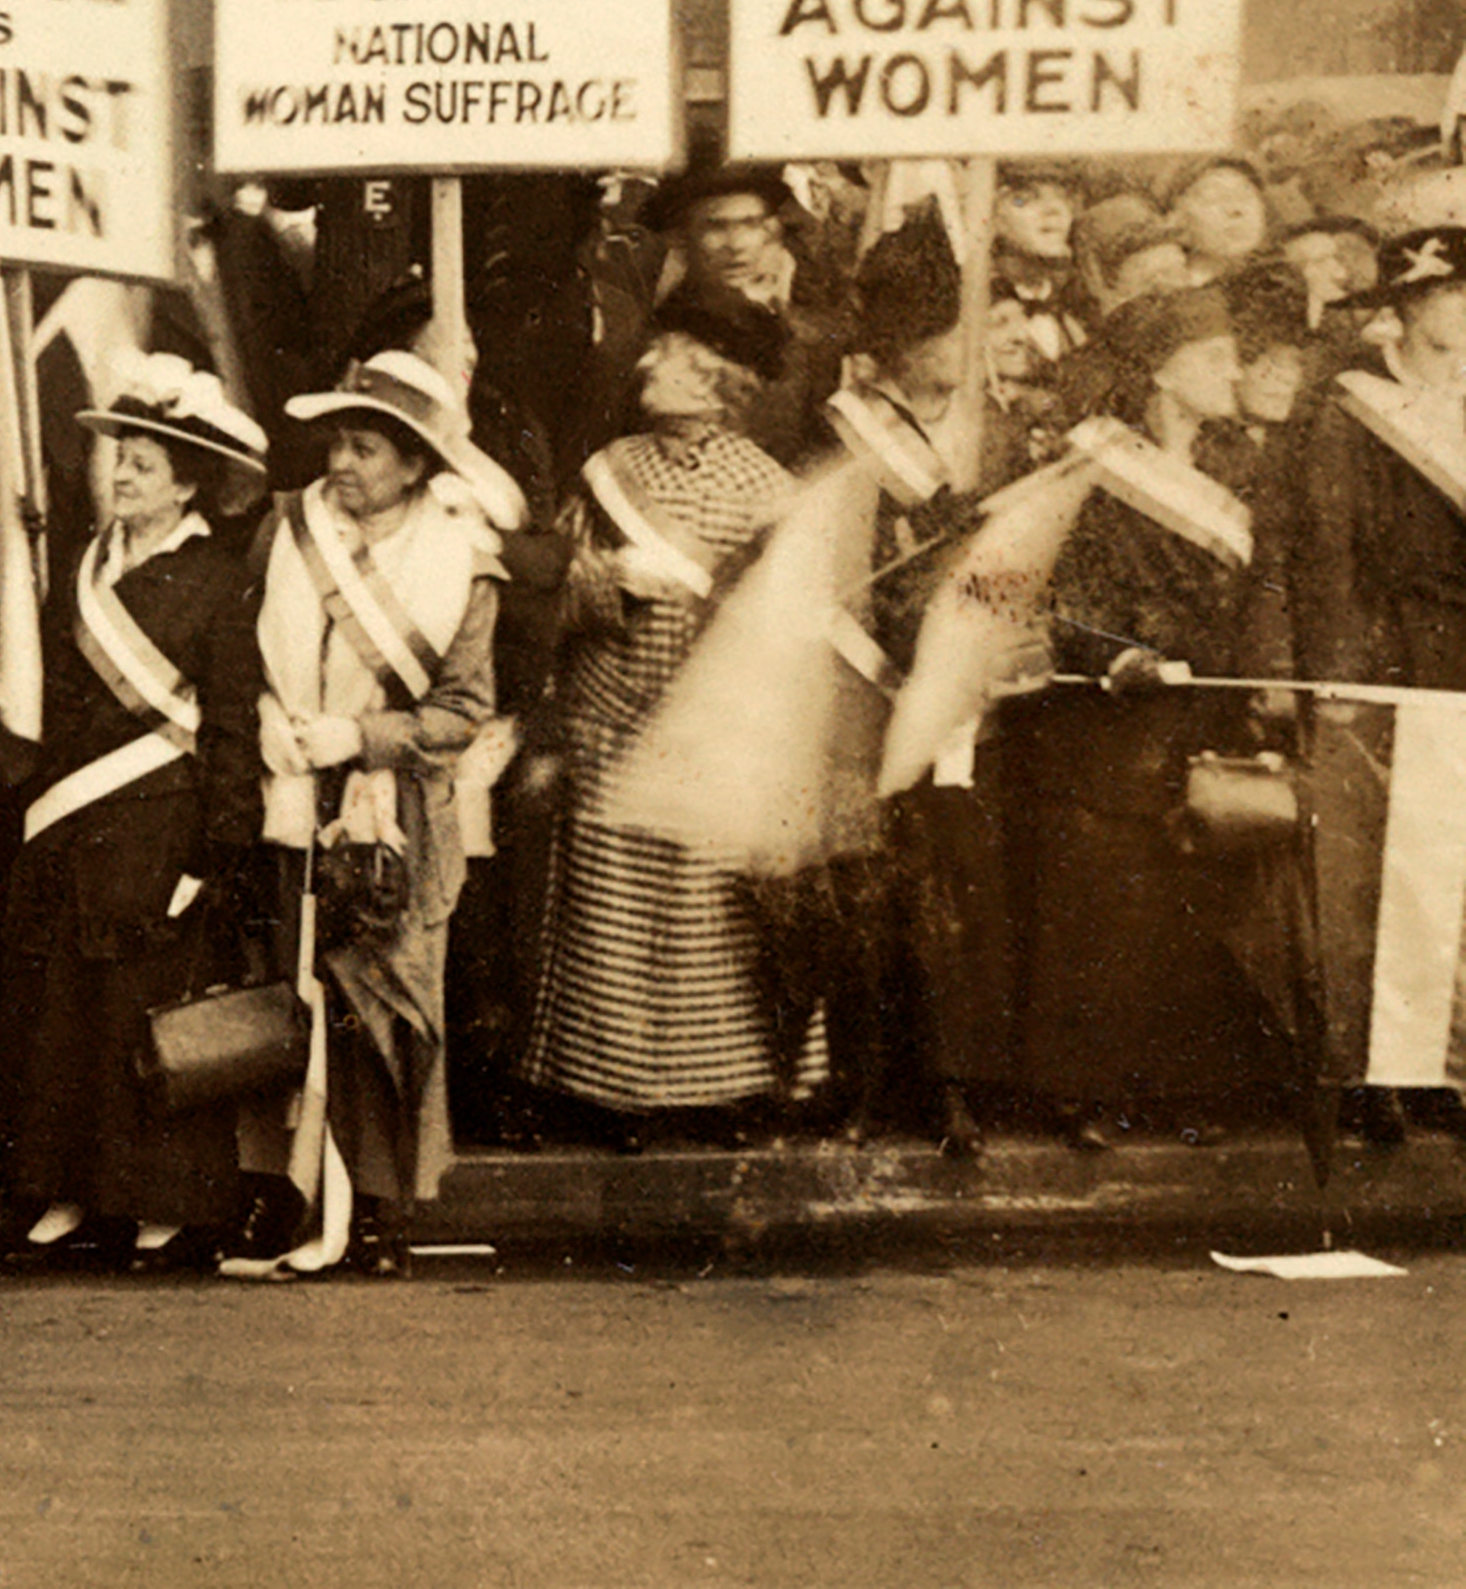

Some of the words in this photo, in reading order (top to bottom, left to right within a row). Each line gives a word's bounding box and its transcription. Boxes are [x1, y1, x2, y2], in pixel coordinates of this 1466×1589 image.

[333, 21, 550, 66] NATIONAL
[242, 80, 386, 127] WOMAN
[402, 77, 639, 126] SUFFRAGE
[804, 48, 1143, 118] WOMEN
